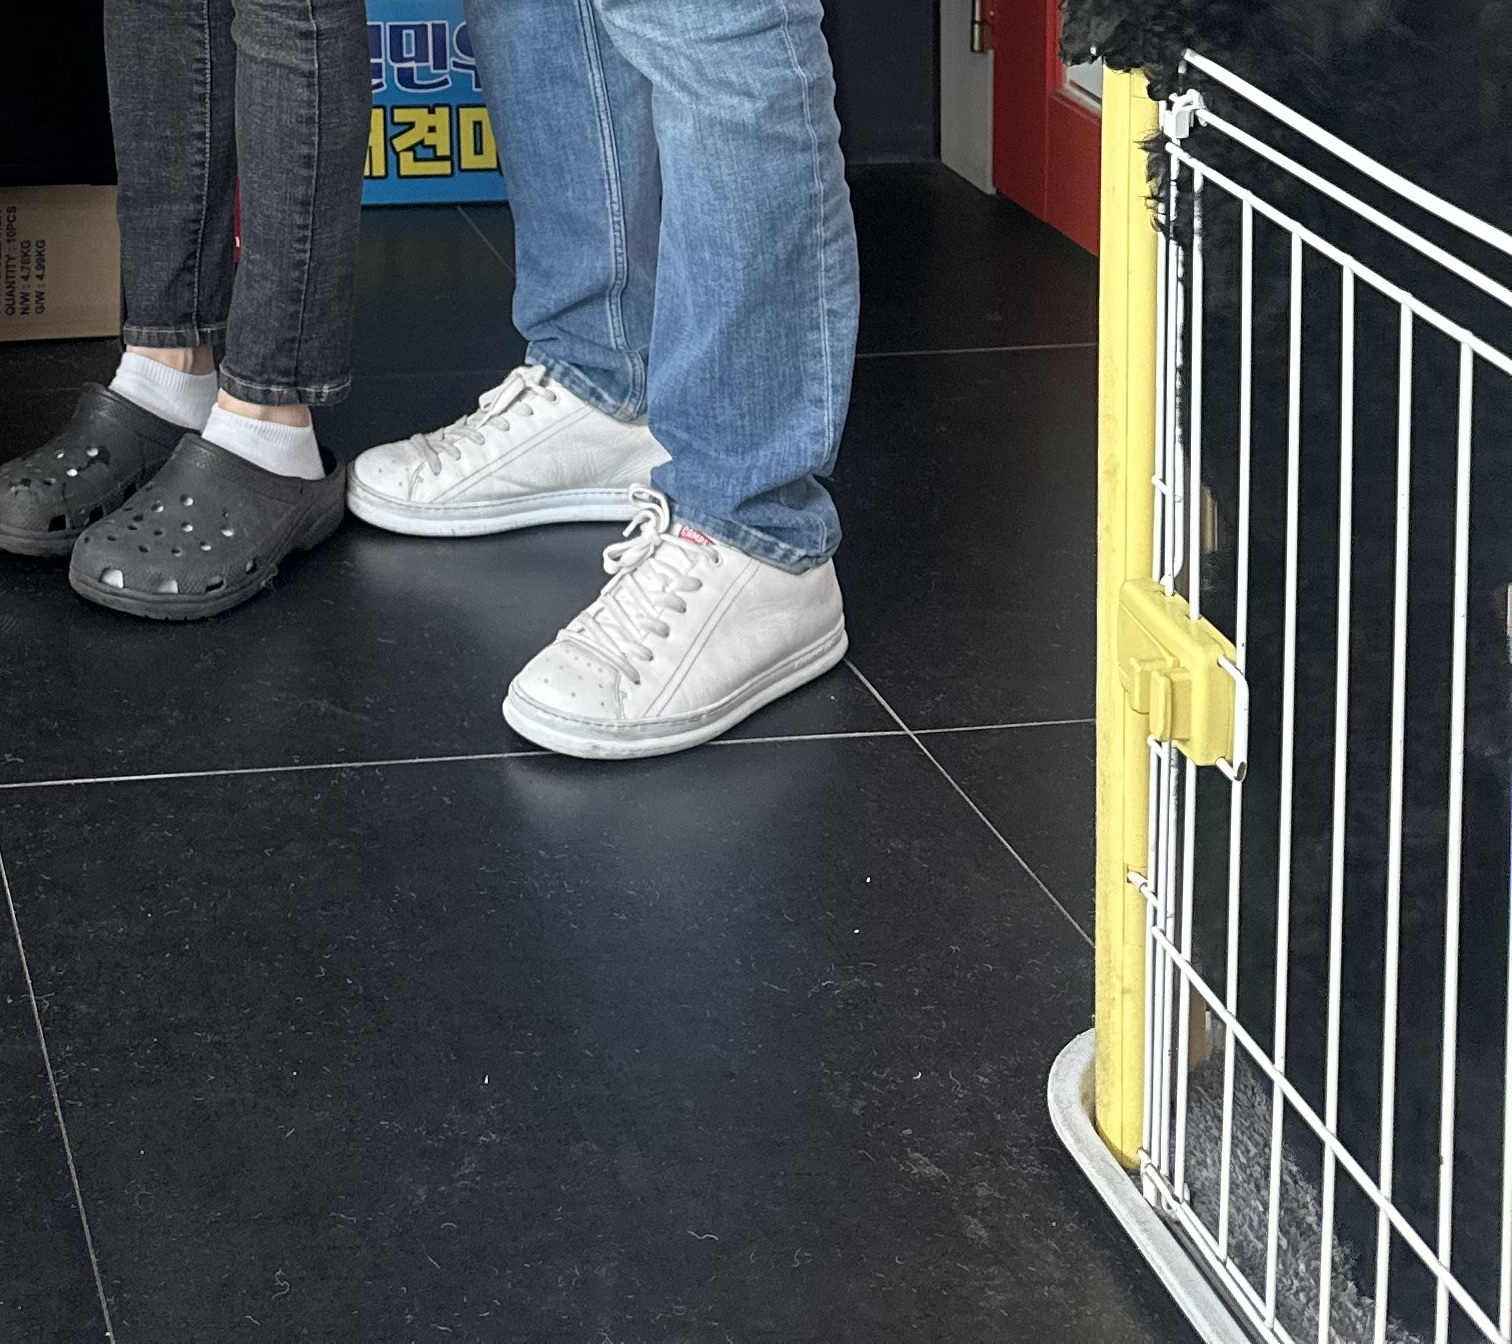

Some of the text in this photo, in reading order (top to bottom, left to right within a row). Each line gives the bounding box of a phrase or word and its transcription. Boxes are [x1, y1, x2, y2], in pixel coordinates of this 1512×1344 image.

[6, 206, 17, 244] 10PCS
[5, 255, 17, 316] QUANTITY
[20, 292, 31, 316] N/W
[34, 290, 45, 315] G/W
